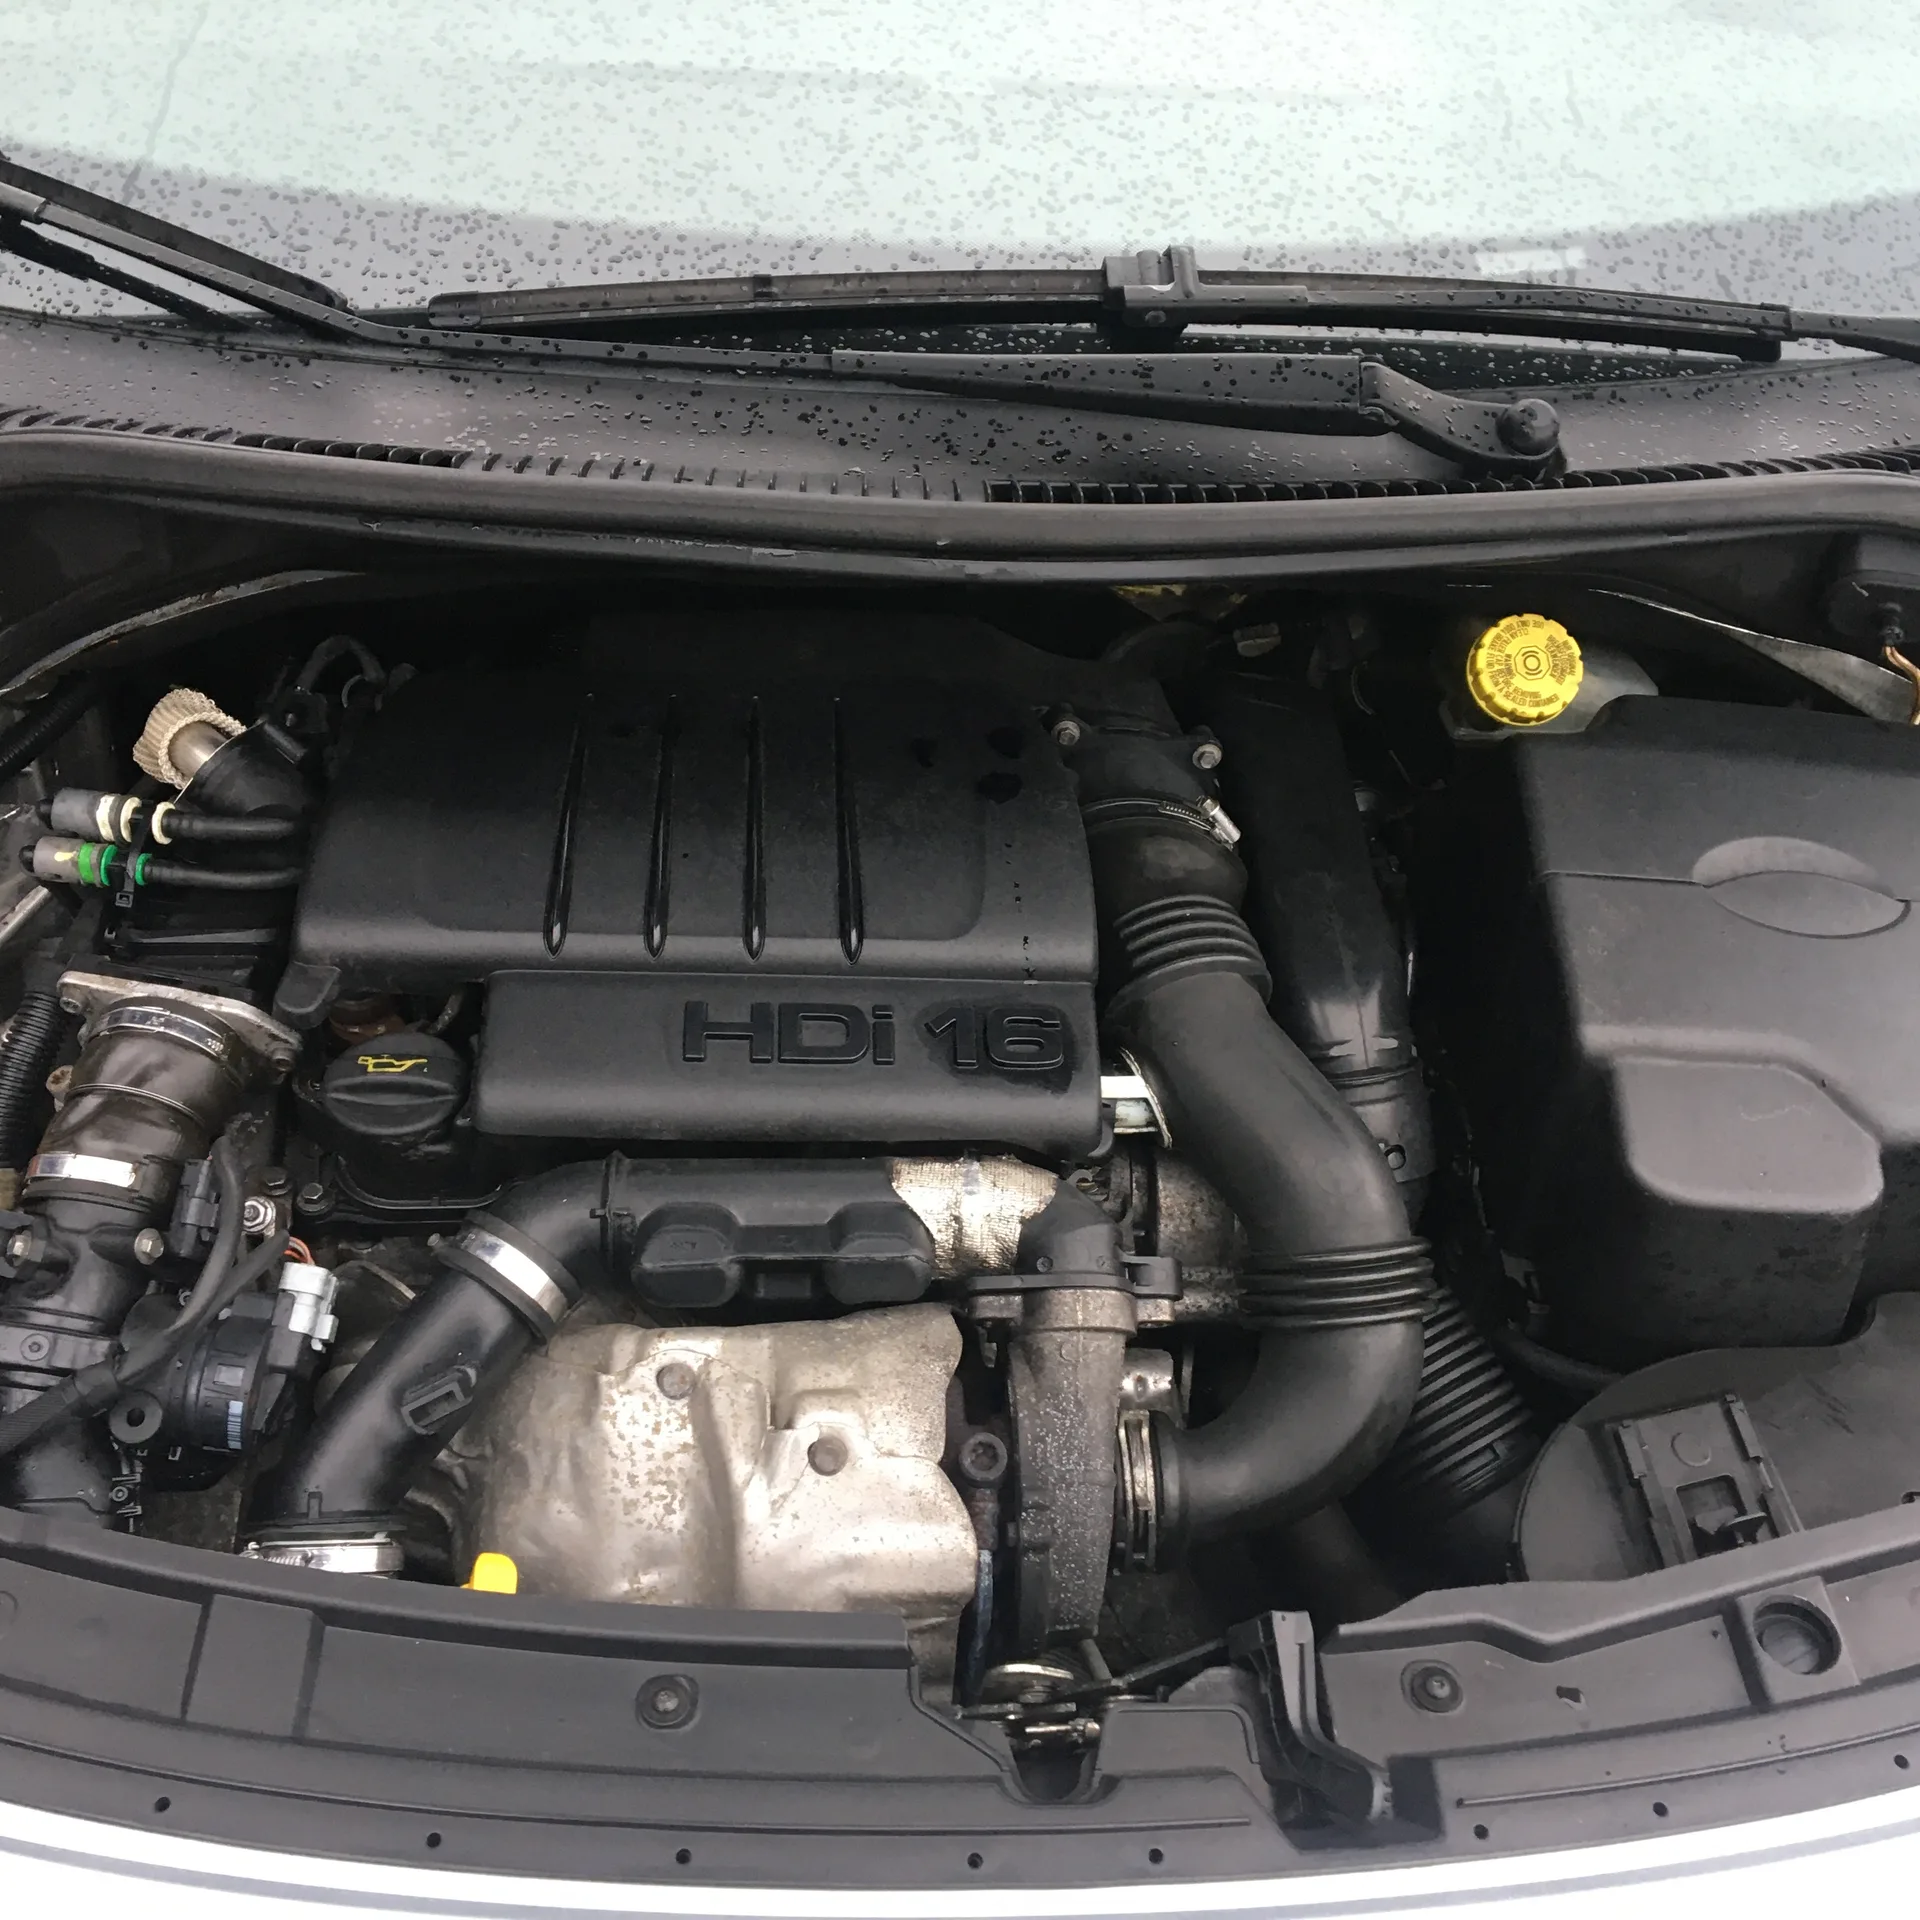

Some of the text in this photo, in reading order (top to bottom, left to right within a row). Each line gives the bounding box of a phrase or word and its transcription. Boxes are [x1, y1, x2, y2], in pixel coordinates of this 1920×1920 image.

[1509, 627, 1529, 640] CLEAN
[1488, 632, 1504, 652] BRAKE
[1486, 652, 1495, 669] FLUID
[1495, 654, 1504, 667] CAP
[1503, 691, 1527, 706] SEALED
[1528, 693, 1560, 708] CONTAINER
[682, 1001, 1065, 1070] HDi 16
